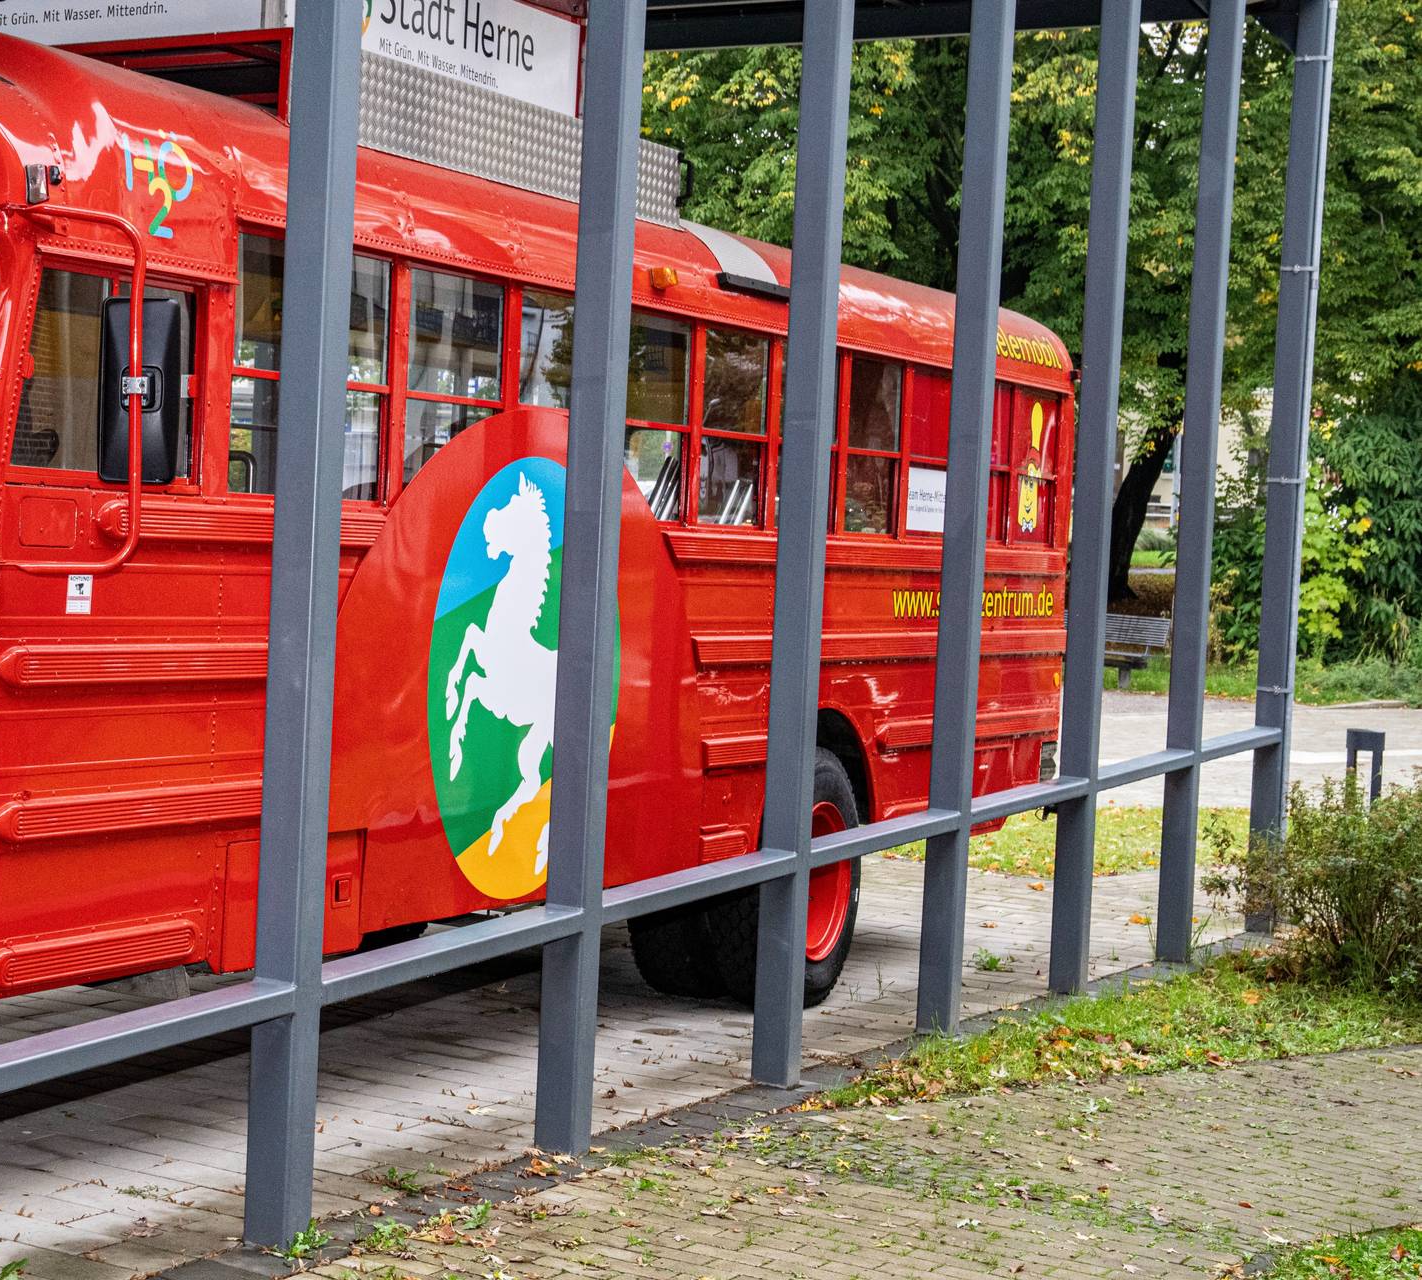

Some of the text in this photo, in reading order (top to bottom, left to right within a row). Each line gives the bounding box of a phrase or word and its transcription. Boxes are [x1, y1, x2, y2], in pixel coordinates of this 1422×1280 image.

[11, 13, 38, 25] Grün.
[43, 10, 60, 22] Mit
[64, 9, 102, 20] Wasser.
[107, 2, 168, 17] Mittendrin.
[463, 0, 534, 71] Herne
[379, 38, 499, 88] Mit Grün. Mit Wasser. Mittendrin.
[996, 325, 1062, 369] elemobil
